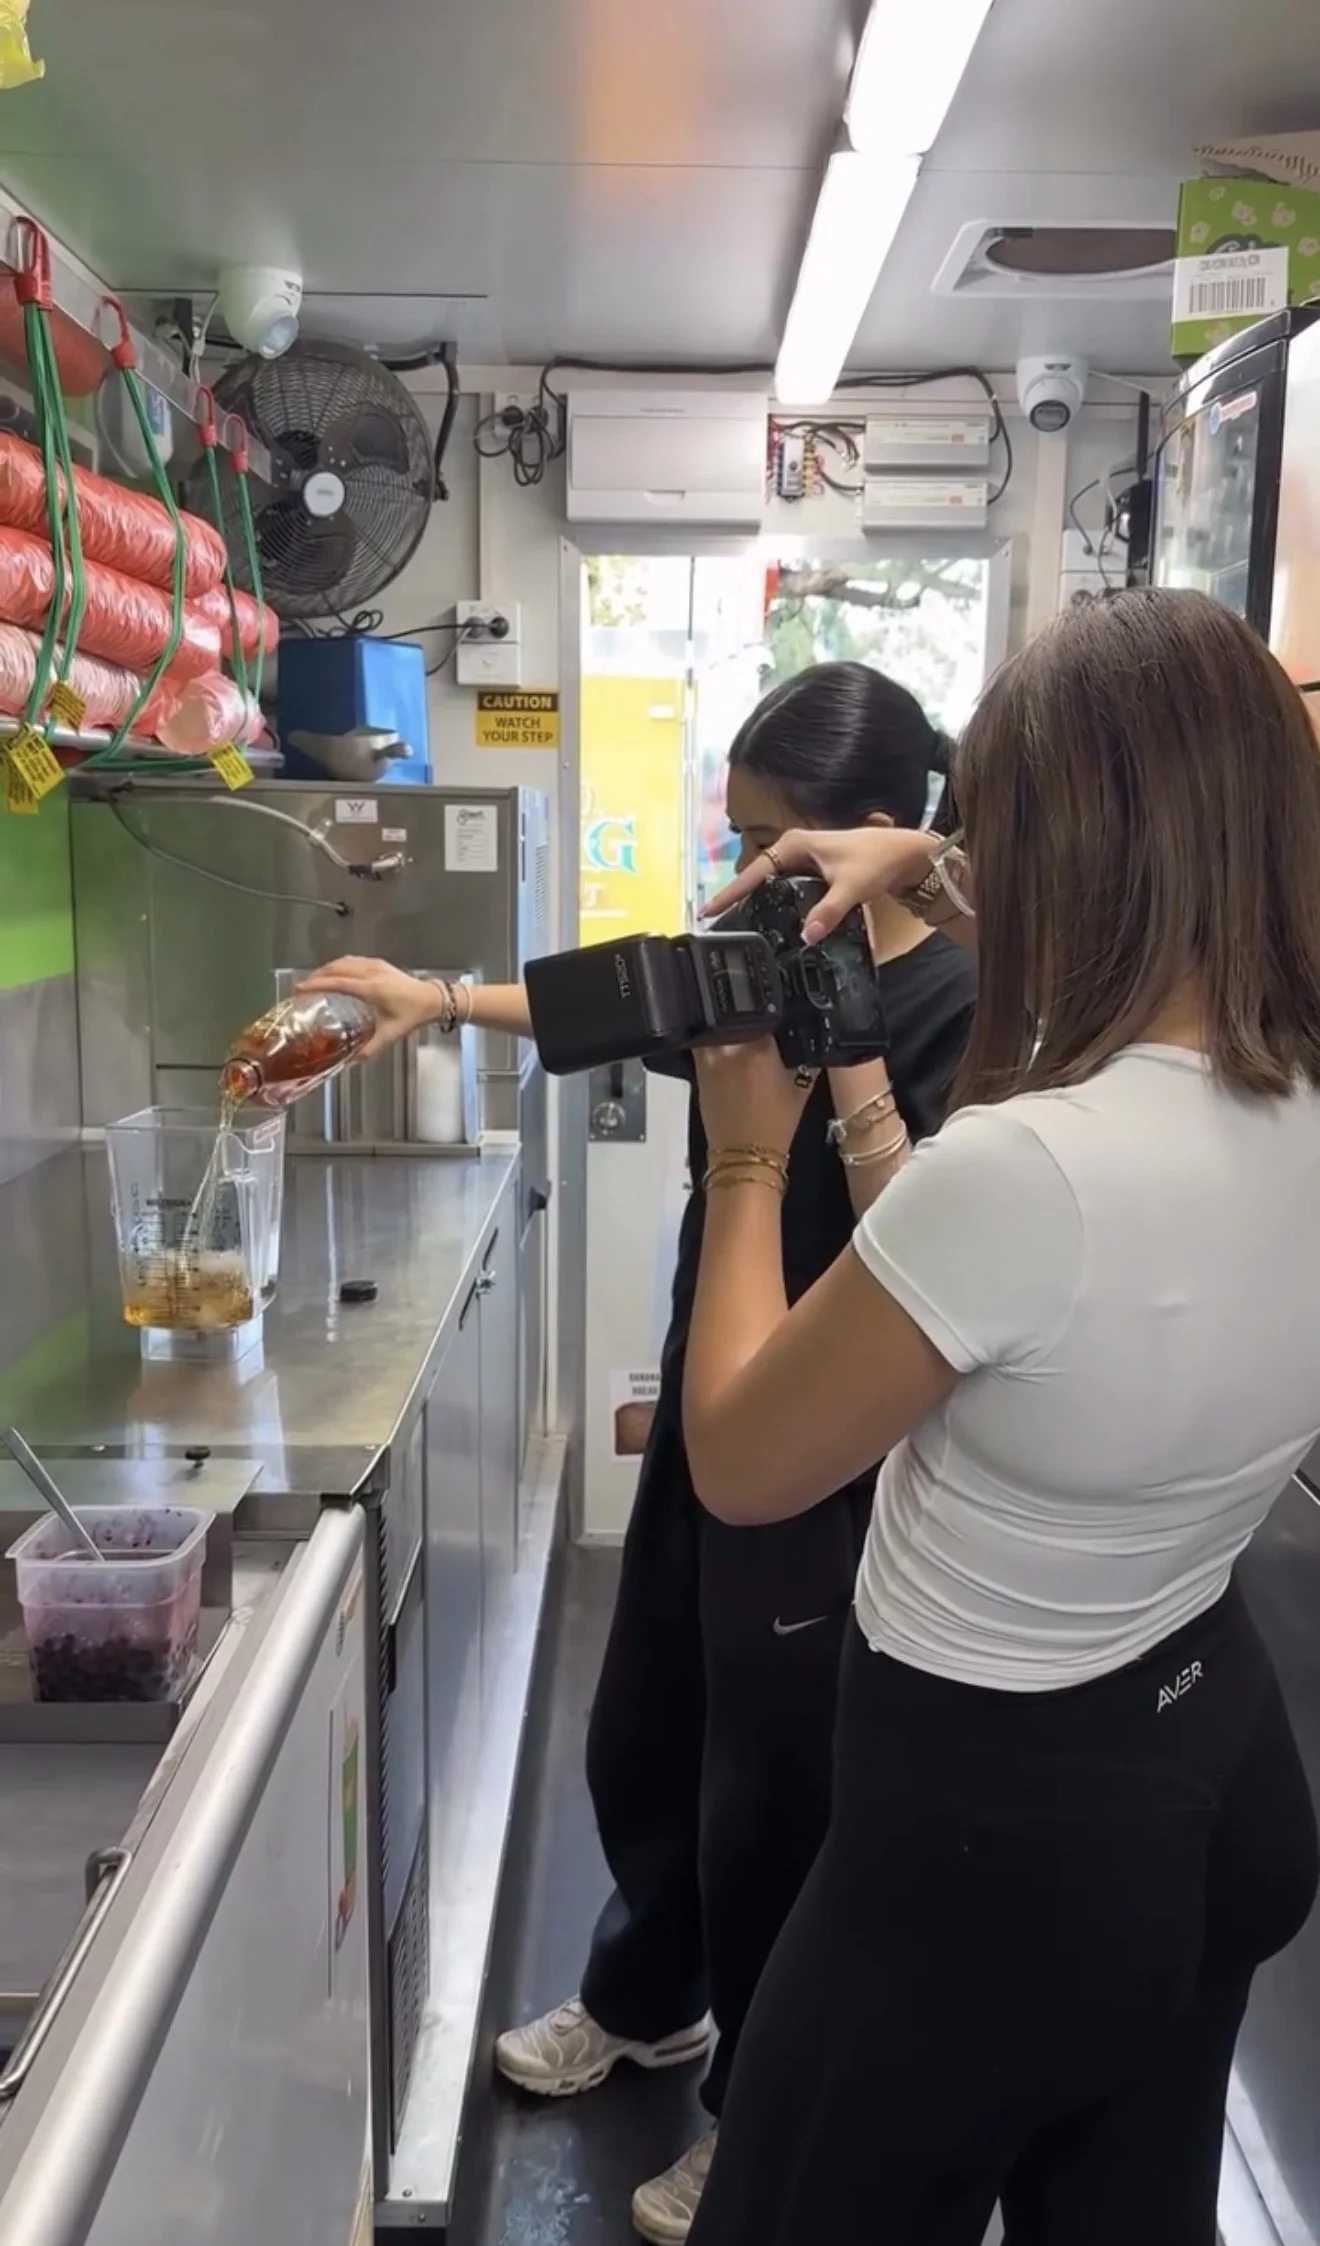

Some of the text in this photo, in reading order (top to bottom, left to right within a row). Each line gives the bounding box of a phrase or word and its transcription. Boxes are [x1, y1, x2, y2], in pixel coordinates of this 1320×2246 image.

[483, 695, 553, 709] CAUTION
[494, 716, 541, 729] WATCH
[482, 730, 554, 743] YOUR STEP
